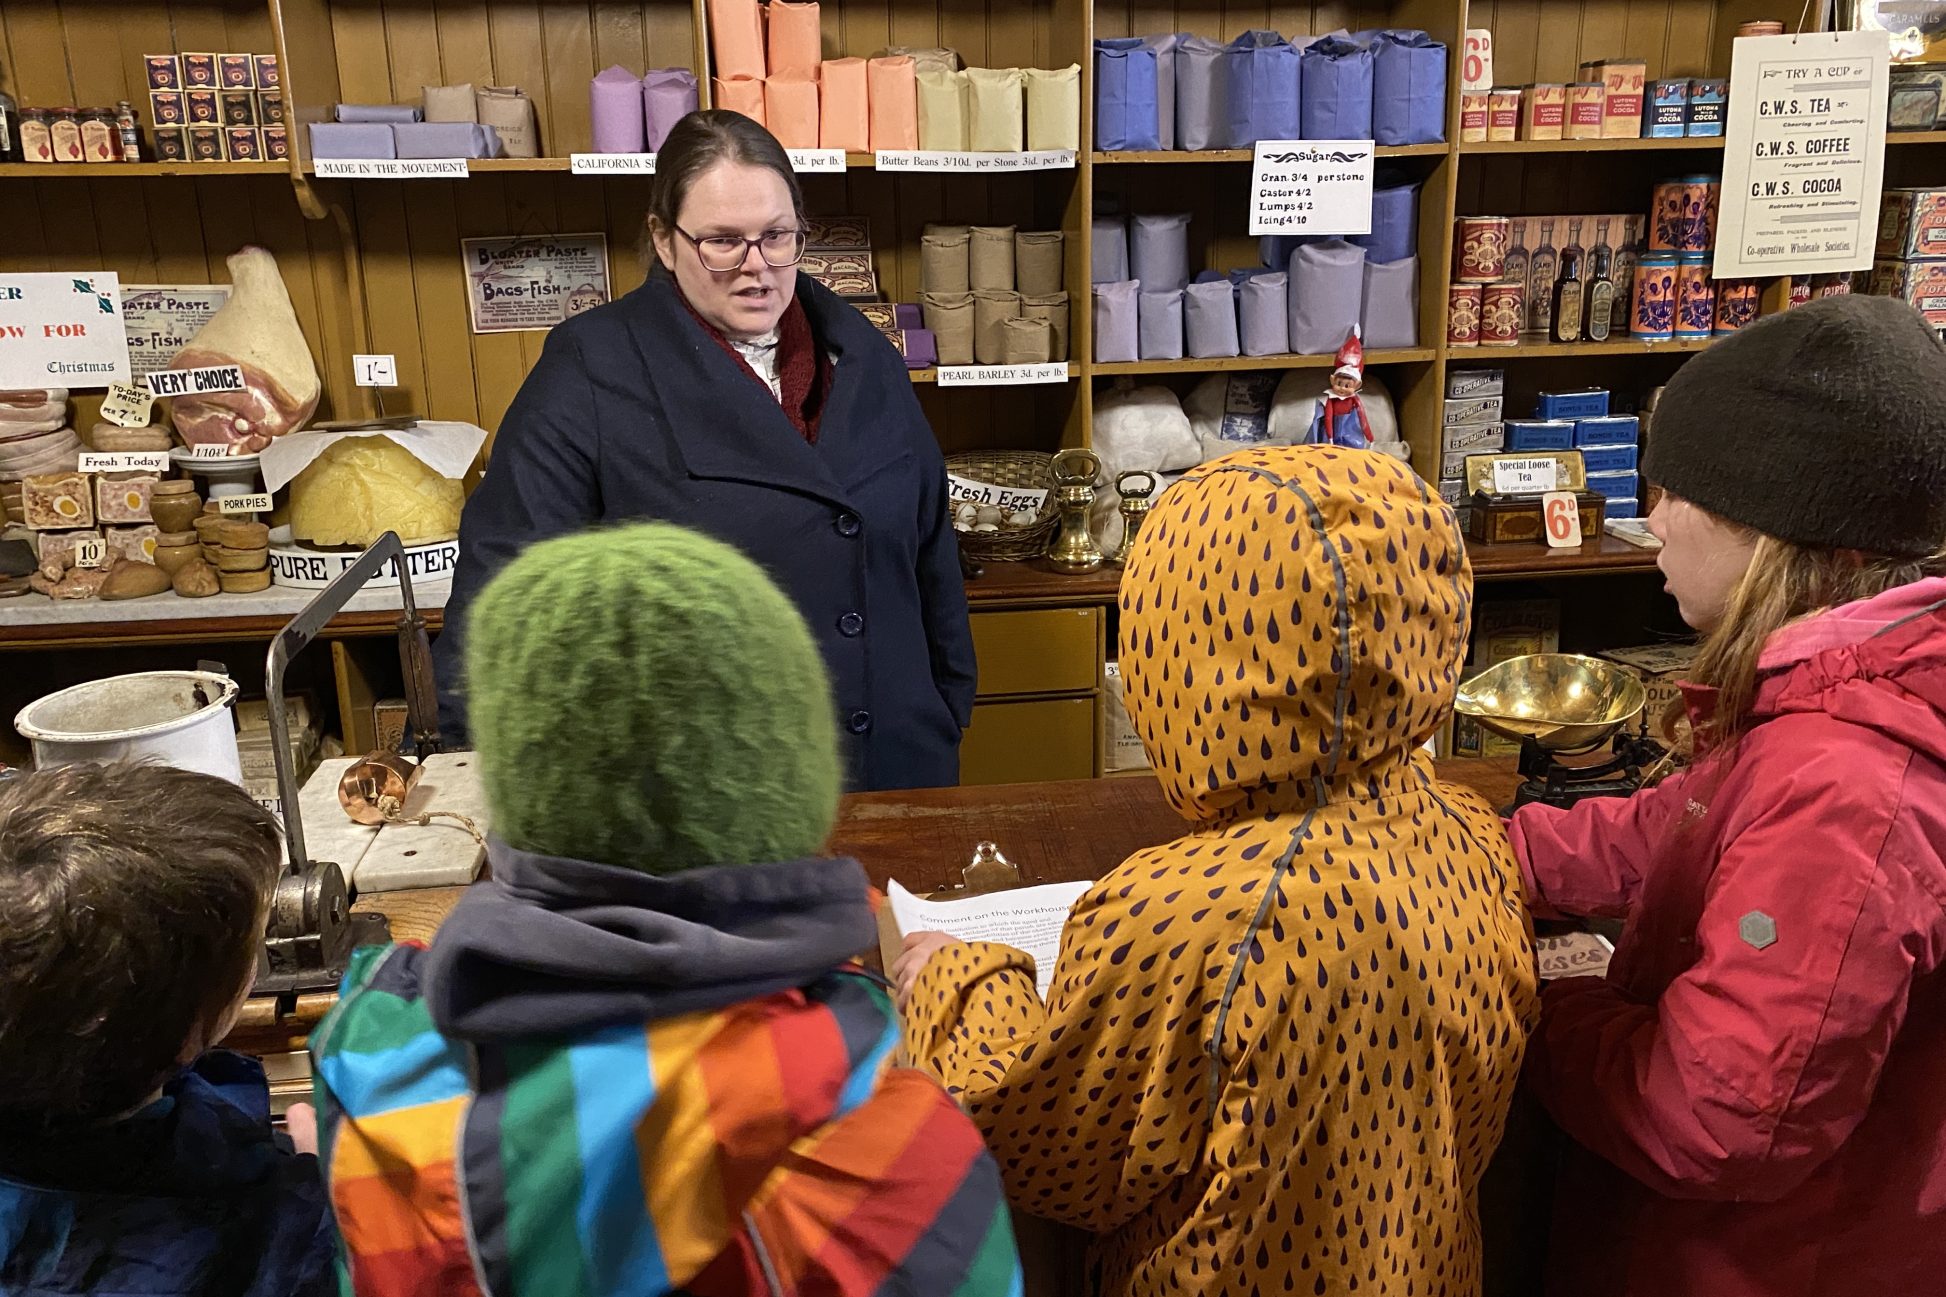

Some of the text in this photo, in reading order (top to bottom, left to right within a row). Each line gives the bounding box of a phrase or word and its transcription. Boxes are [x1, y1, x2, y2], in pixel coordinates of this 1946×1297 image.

[1786, 68, 1809, 79] TRY
[1814, 68, 1822, 78] A
[1828, 66, 1850, 77] CUP
[1760, 98, 1831, 116] C.W.S. TEA
[1755, 137, 1850, 157] C.W.S. COFFEE
[577, 159, 640, 169] CALIFORNIA
[793, 156, 840, 168] 3d. per lb.
[882, 154, 1070, 169] Butter Beans 3/10d. per Stone per lb.
[1299, 152, 1331, 163] Sugar
[323, 162, 465, 174] MADE IN THE MOVEMENT
[1261, 173, 1365, 183] Gran. 3/4 per stone
[1296, 188, 1312, 196] 4/2
[1752, 178, 1842, 197] C.W.S. COCOA
[1259, 202, 1313, 212] Lumps 4/2
[1258, 216, 1307, 226] Icing 4/10
[478, 244, 588, 266] BLOATER PASTE
[1747, 242, 1820, 257] Co-operative Wholesale
[483, 282, 524, 302] BAGS
[530, 280, 561, 299] FISH
[166, 298, 210, 310] PASTE
[43, 324, 87, 338] FOR
[151, 332, 184, 350] FISH
[47, 361, 115, 375] Christmas
[942, 367, 1064, 381] PEARL BARLEY 3d. per lb.
[148, 368, 242, 395] VERY CHOICE
[113, 384, 151, 401] TO-DAY'S
[117, 393, 142, 406] PRICE
[1487, 400, 1498, 409] TEA
[103, 407, 116, 415] PER
[1490, 427, 1502, 435] TEA
[85, 457, 162, 468] Fresh Today
[1499, 460, 1551, 471] Special Loose
[1519, 473, 1532, 482] Tea
[224, 498, 267, 509] PORK PIES
[996, 490, 1041, 512] Eggs
[270, 554, 328, 581] PURE
[920, 913, 971, 923] Comment
[991, 909, 1009, 917] the
